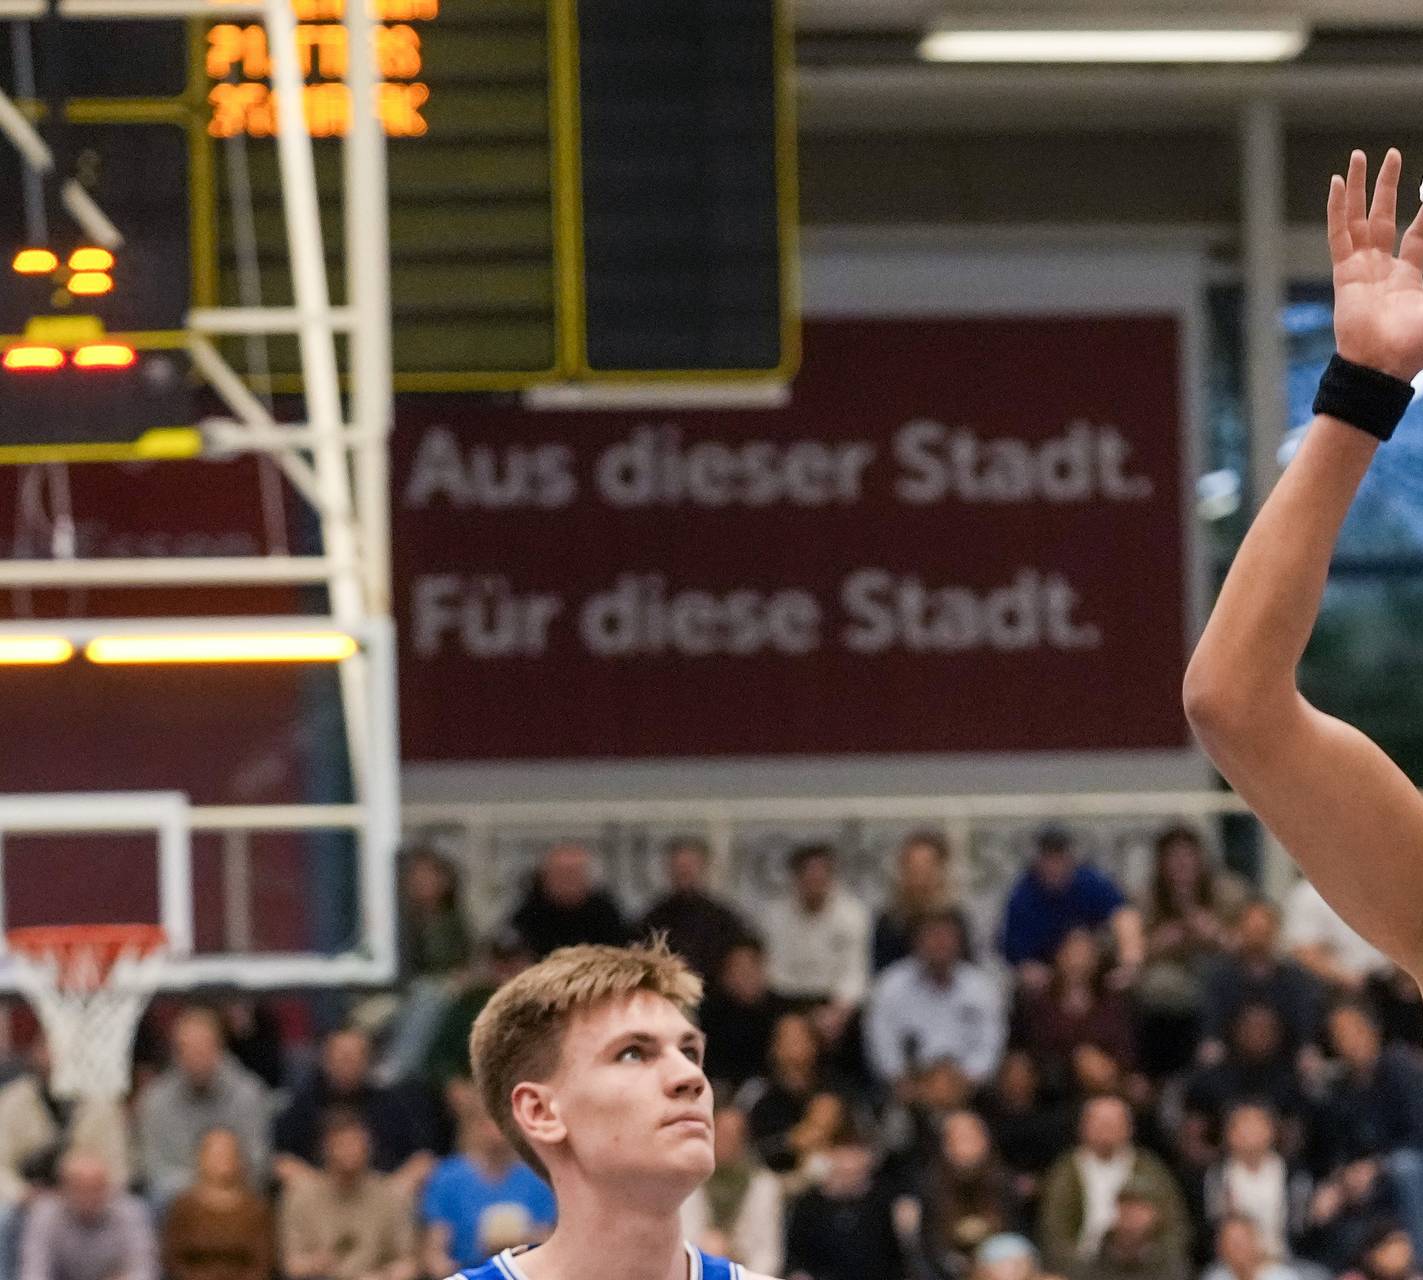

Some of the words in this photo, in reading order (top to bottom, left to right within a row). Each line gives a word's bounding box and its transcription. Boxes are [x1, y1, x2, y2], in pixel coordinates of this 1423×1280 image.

[404, 427, 577, 507] Aus
[595, 424, 877, 506] dieser
[893, 420, 1154, 506] Stadt.
[412, 573, 562, 656] Für
[580, 573, 822, 655] diese
[841, 567, 1103, 652] Stadt.
